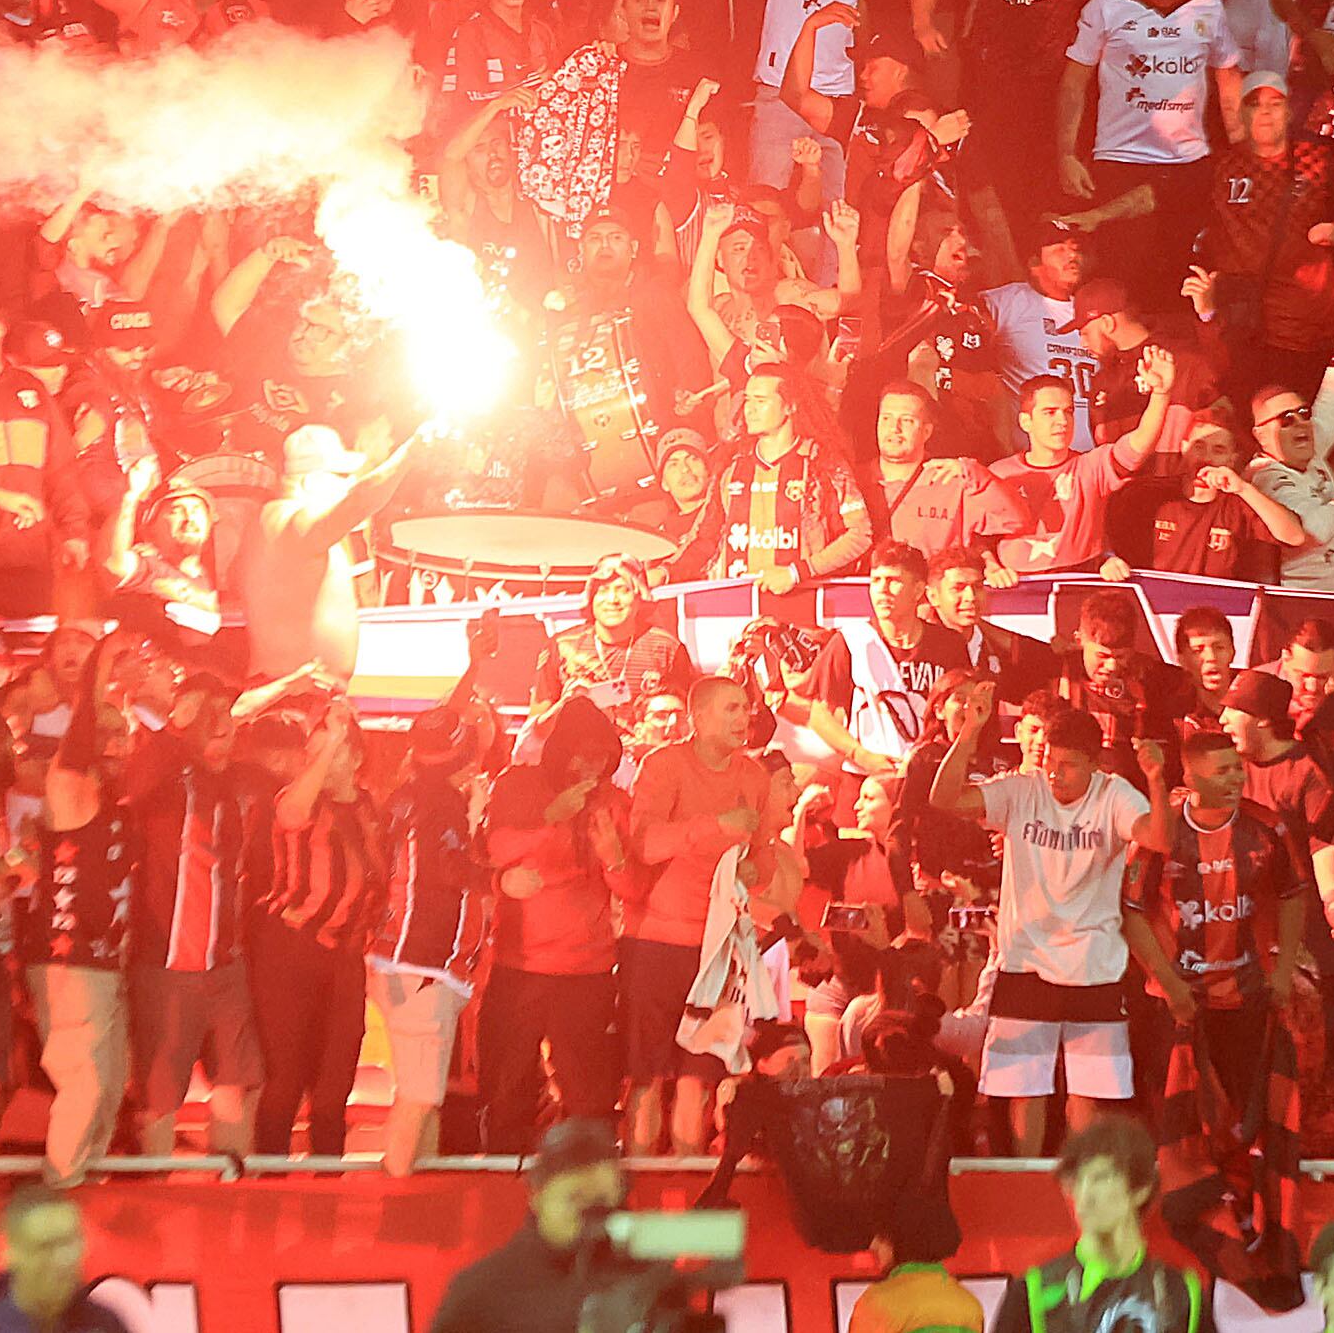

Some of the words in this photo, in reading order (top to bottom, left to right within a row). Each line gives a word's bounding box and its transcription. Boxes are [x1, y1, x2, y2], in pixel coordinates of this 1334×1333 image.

[1227, 176, 1253, 204] 12
[568, 346, 608, 378] 12
[748, 522, 799, 550] kölbi
